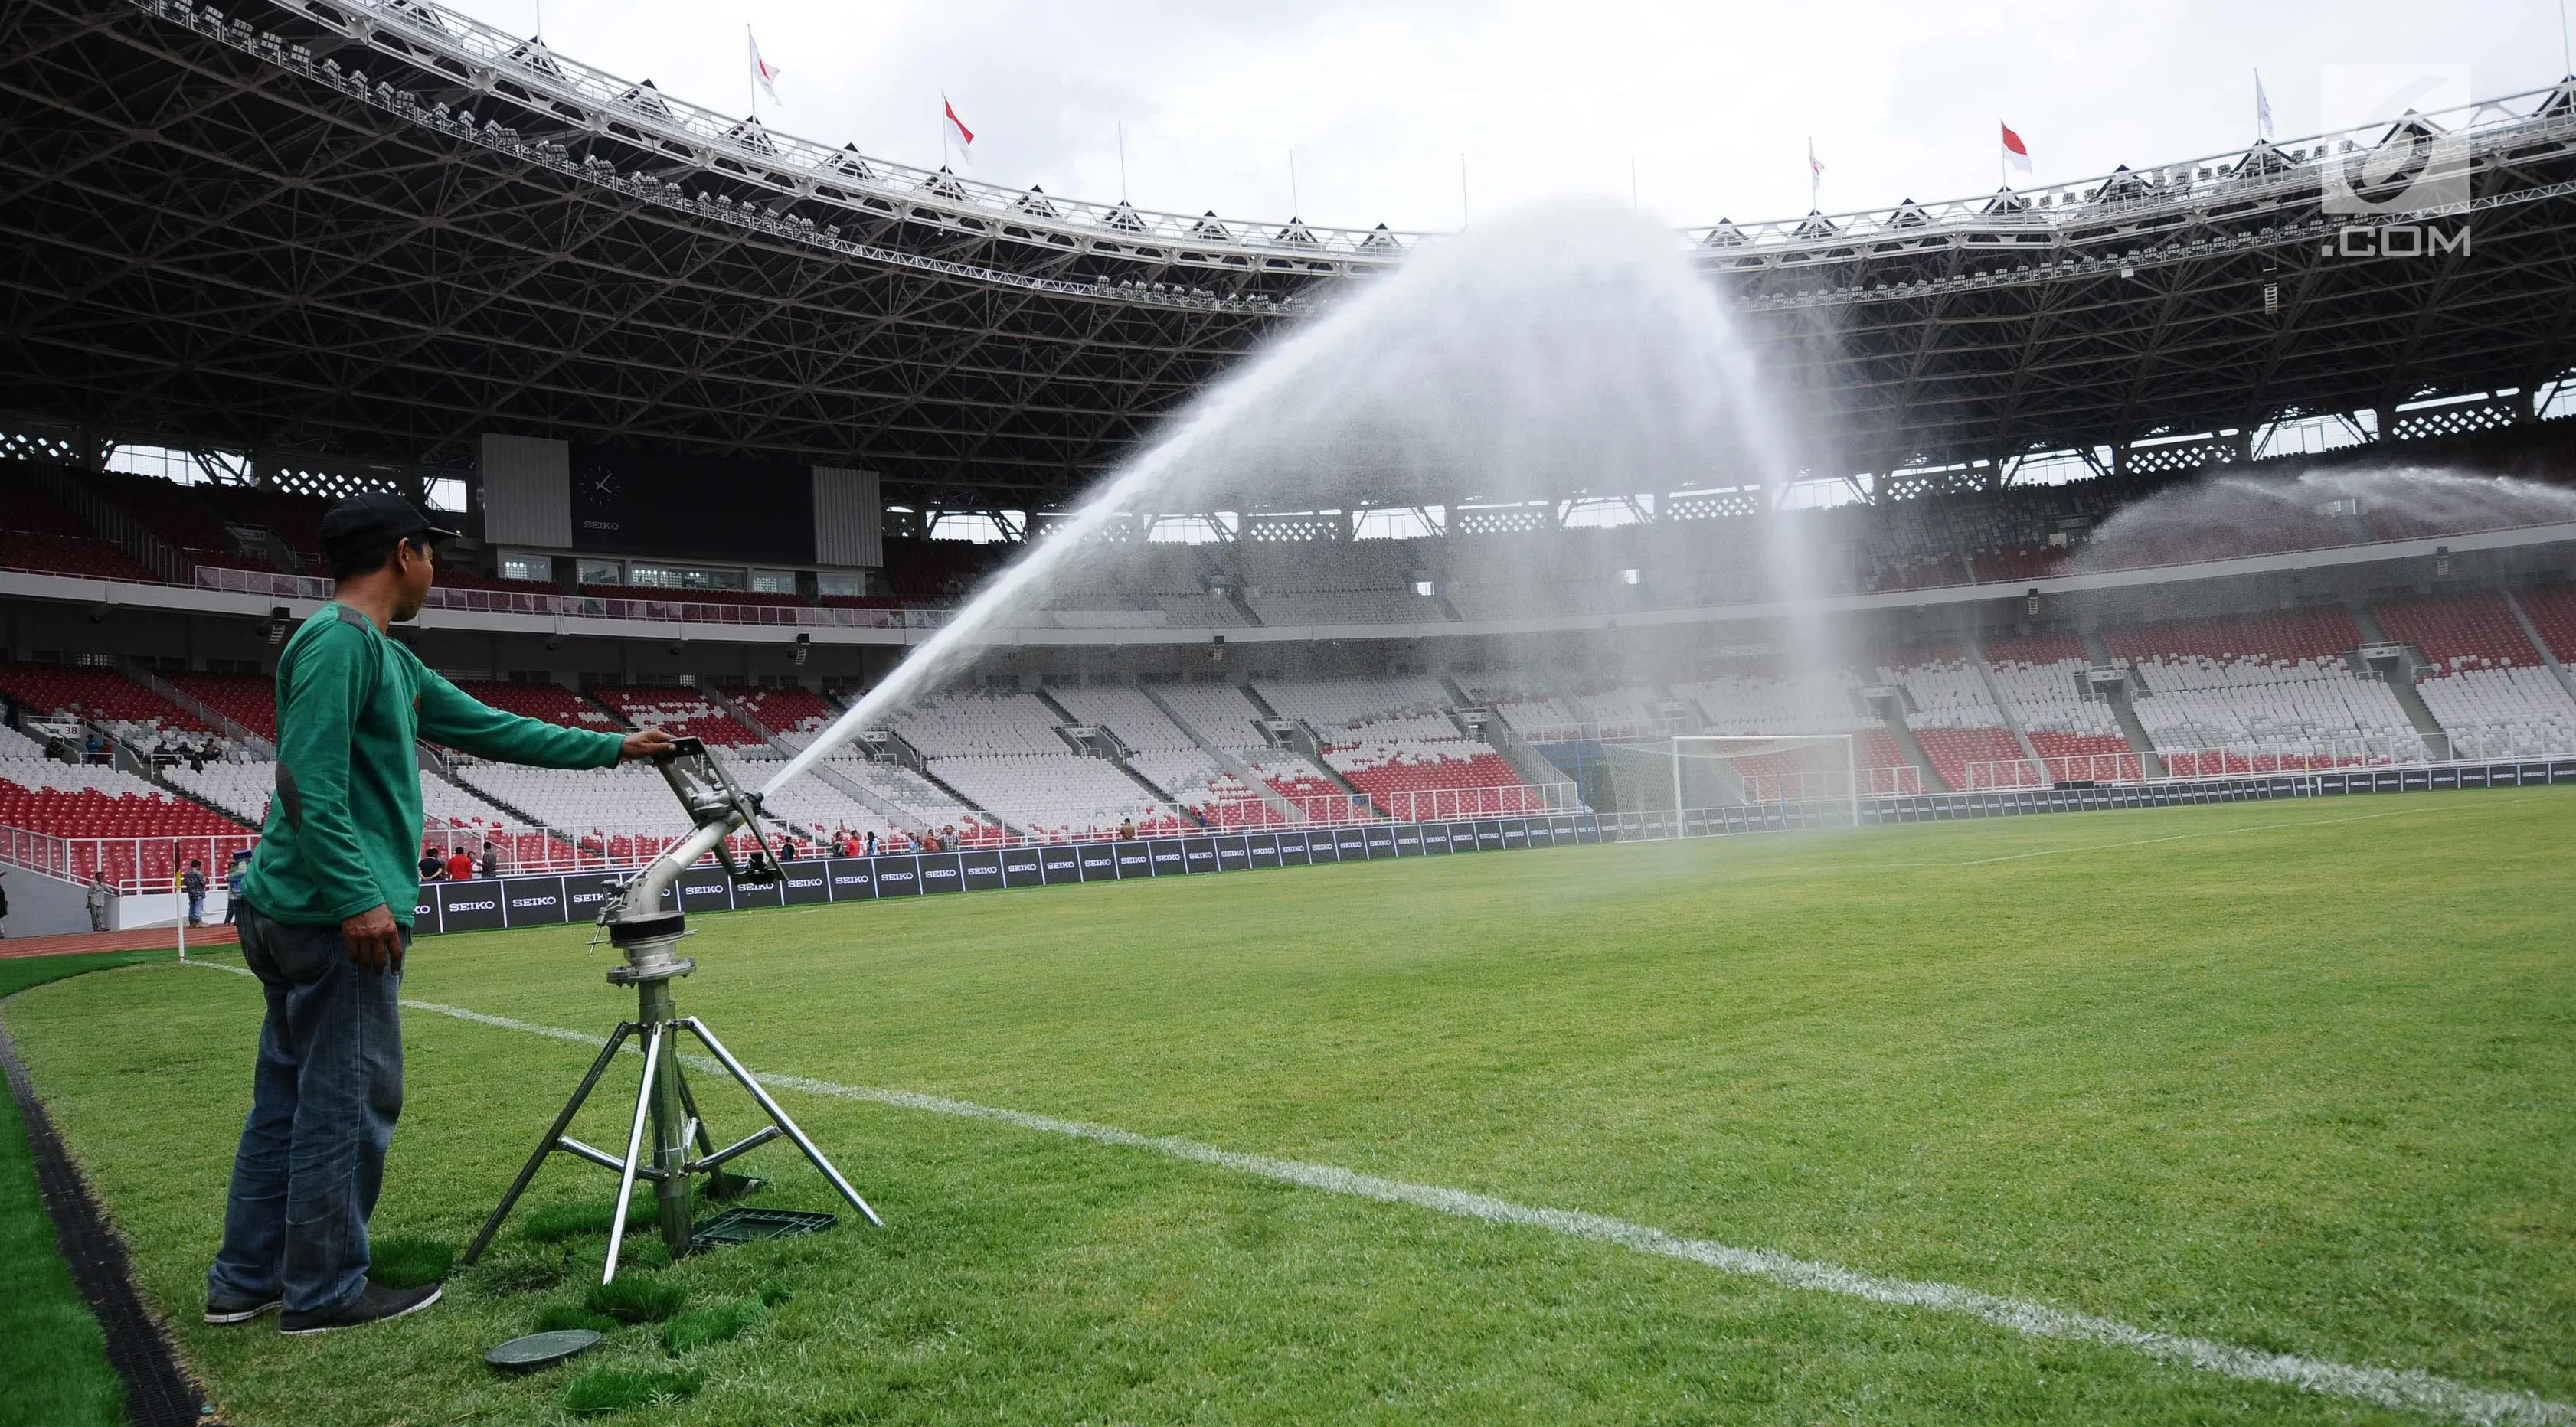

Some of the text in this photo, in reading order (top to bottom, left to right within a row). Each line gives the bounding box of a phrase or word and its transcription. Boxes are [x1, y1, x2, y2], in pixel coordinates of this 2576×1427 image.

[584, 521, 619, 530] SEIKO
[65, 727, 77, 735] 38
[1008, 864, 1036, 872] SEIKO
[788, 879, 822, 887] SEIKO
[835, 876, 868, 884] SEIKO
[685, 885, 723, 894] SEIKO
[513, 896, 556, 906] SEIKO
[449, 901, 495, 911] SEIKO
